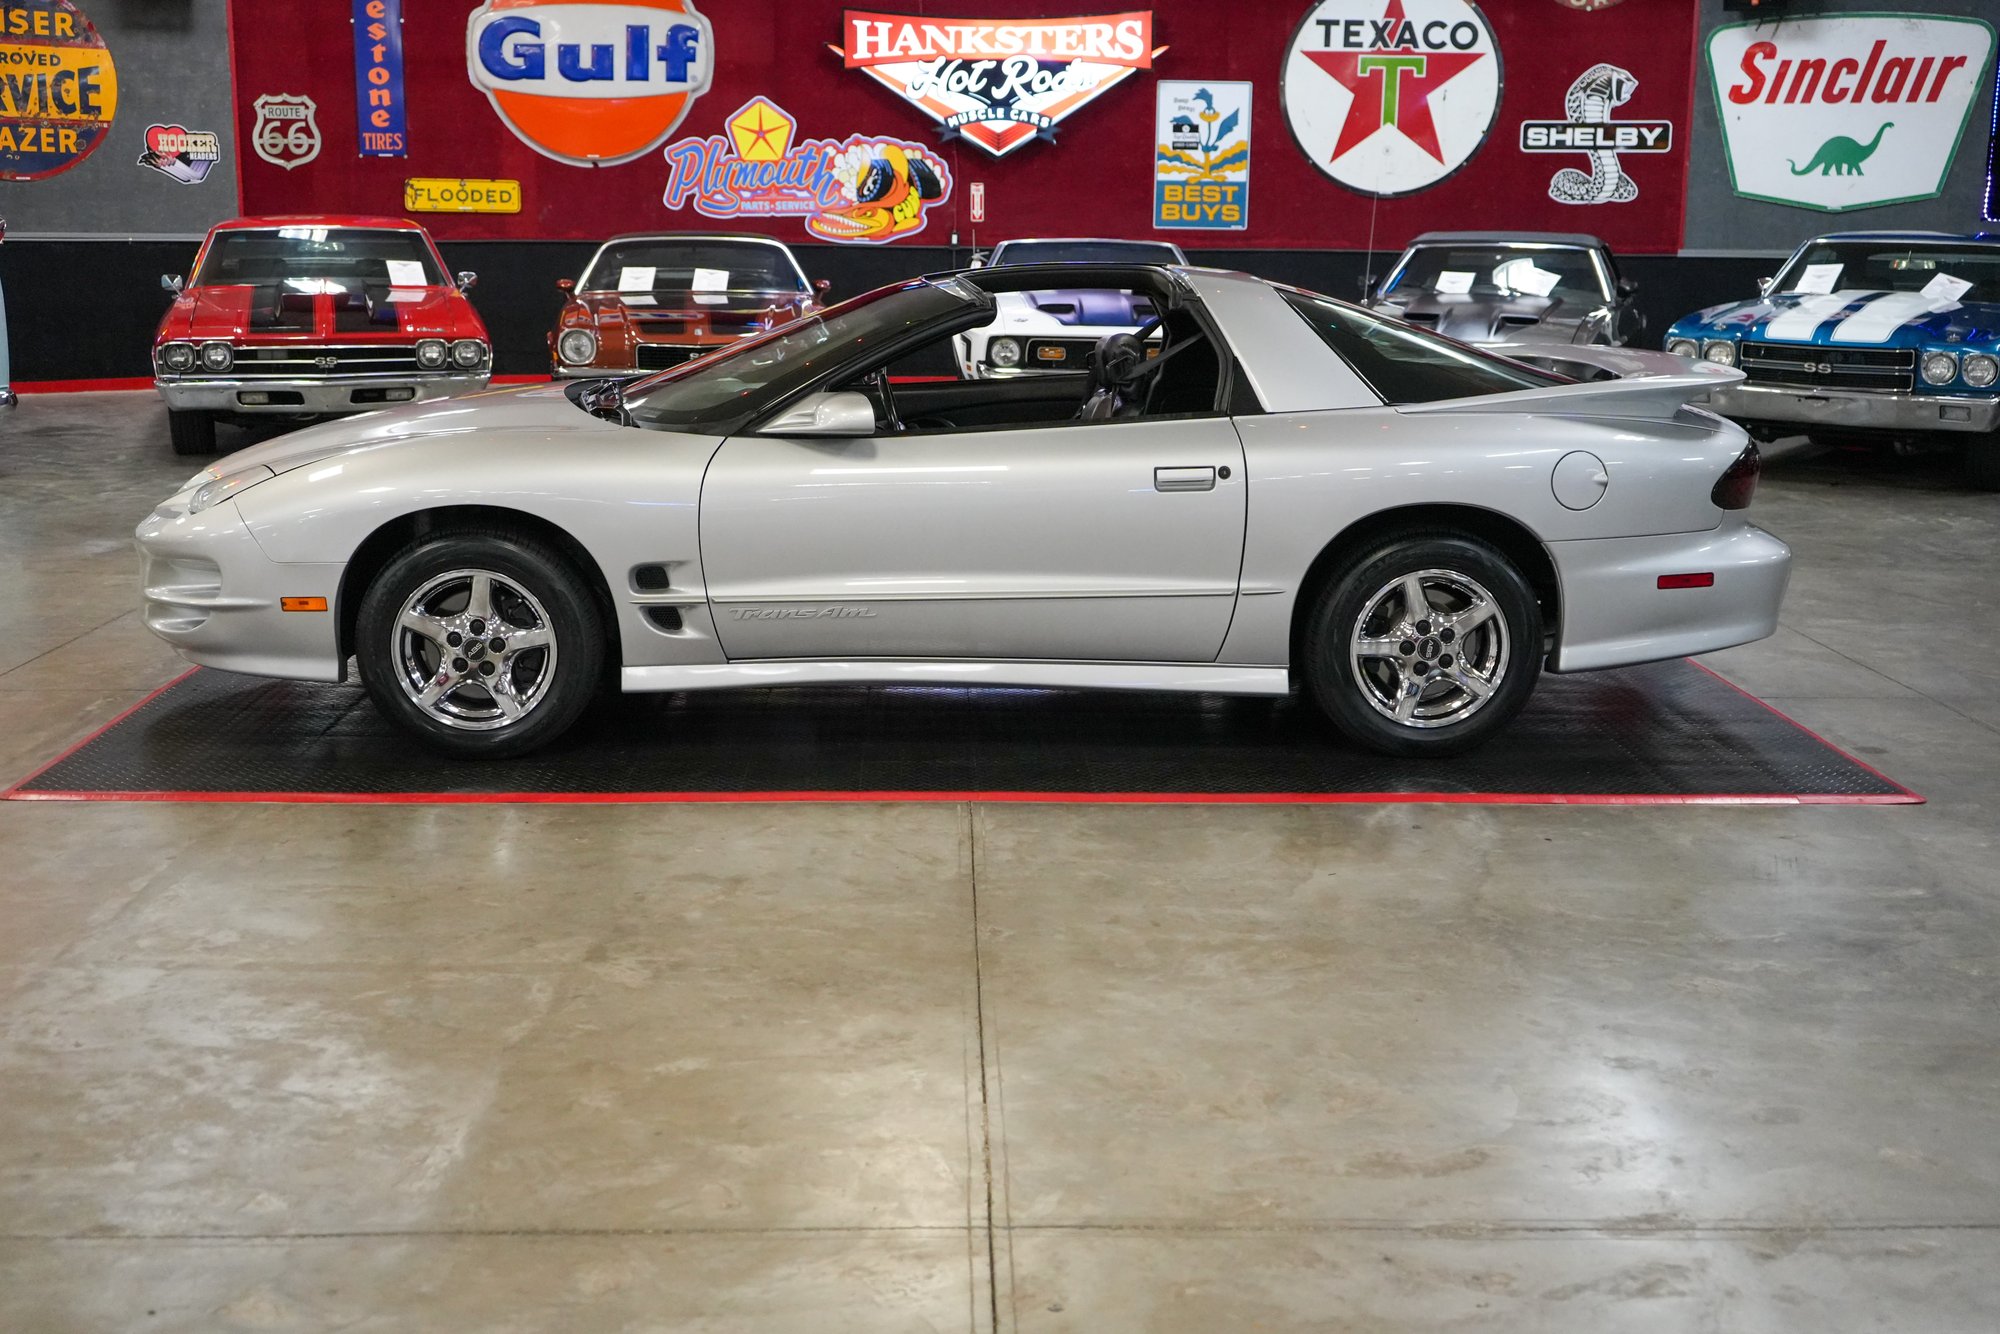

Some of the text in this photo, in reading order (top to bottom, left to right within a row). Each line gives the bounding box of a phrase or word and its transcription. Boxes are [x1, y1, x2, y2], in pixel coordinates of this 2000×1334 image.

[852, 19, 1144, 60] HANKSTERS
[1316, 19, 1479, 50] TEXACO
[478, 16, 699, 82] Gulf
[905, 55, 997, 100] Hot
[1728, 40, 1968, 105] Sinclair
[1360, 56, 1426, 127] T
[268, 107, 301, 117] ROUTE
[947, 108, 1051, 128] MUSCLE CARS
[157, 134, 217, 152] HOOKER
[263, 121, 309, 155] 66
[363, 133, 403, 150] TIRES
[1527, 127, 1663, 147] SHELBY
[671, 142, 841, 211] Plymouth
[414, 188, 512, 203] FLOODED
[1163, 185, 1239, 203] BEST
[775, 201, 815, 211] SERVICE
[1161, 204, 1240, 222] BUYS
[315, 356, 337, 365] SS
[1804, 362, 1831, 374] SS
[468, 642, 482, 658] ABS
